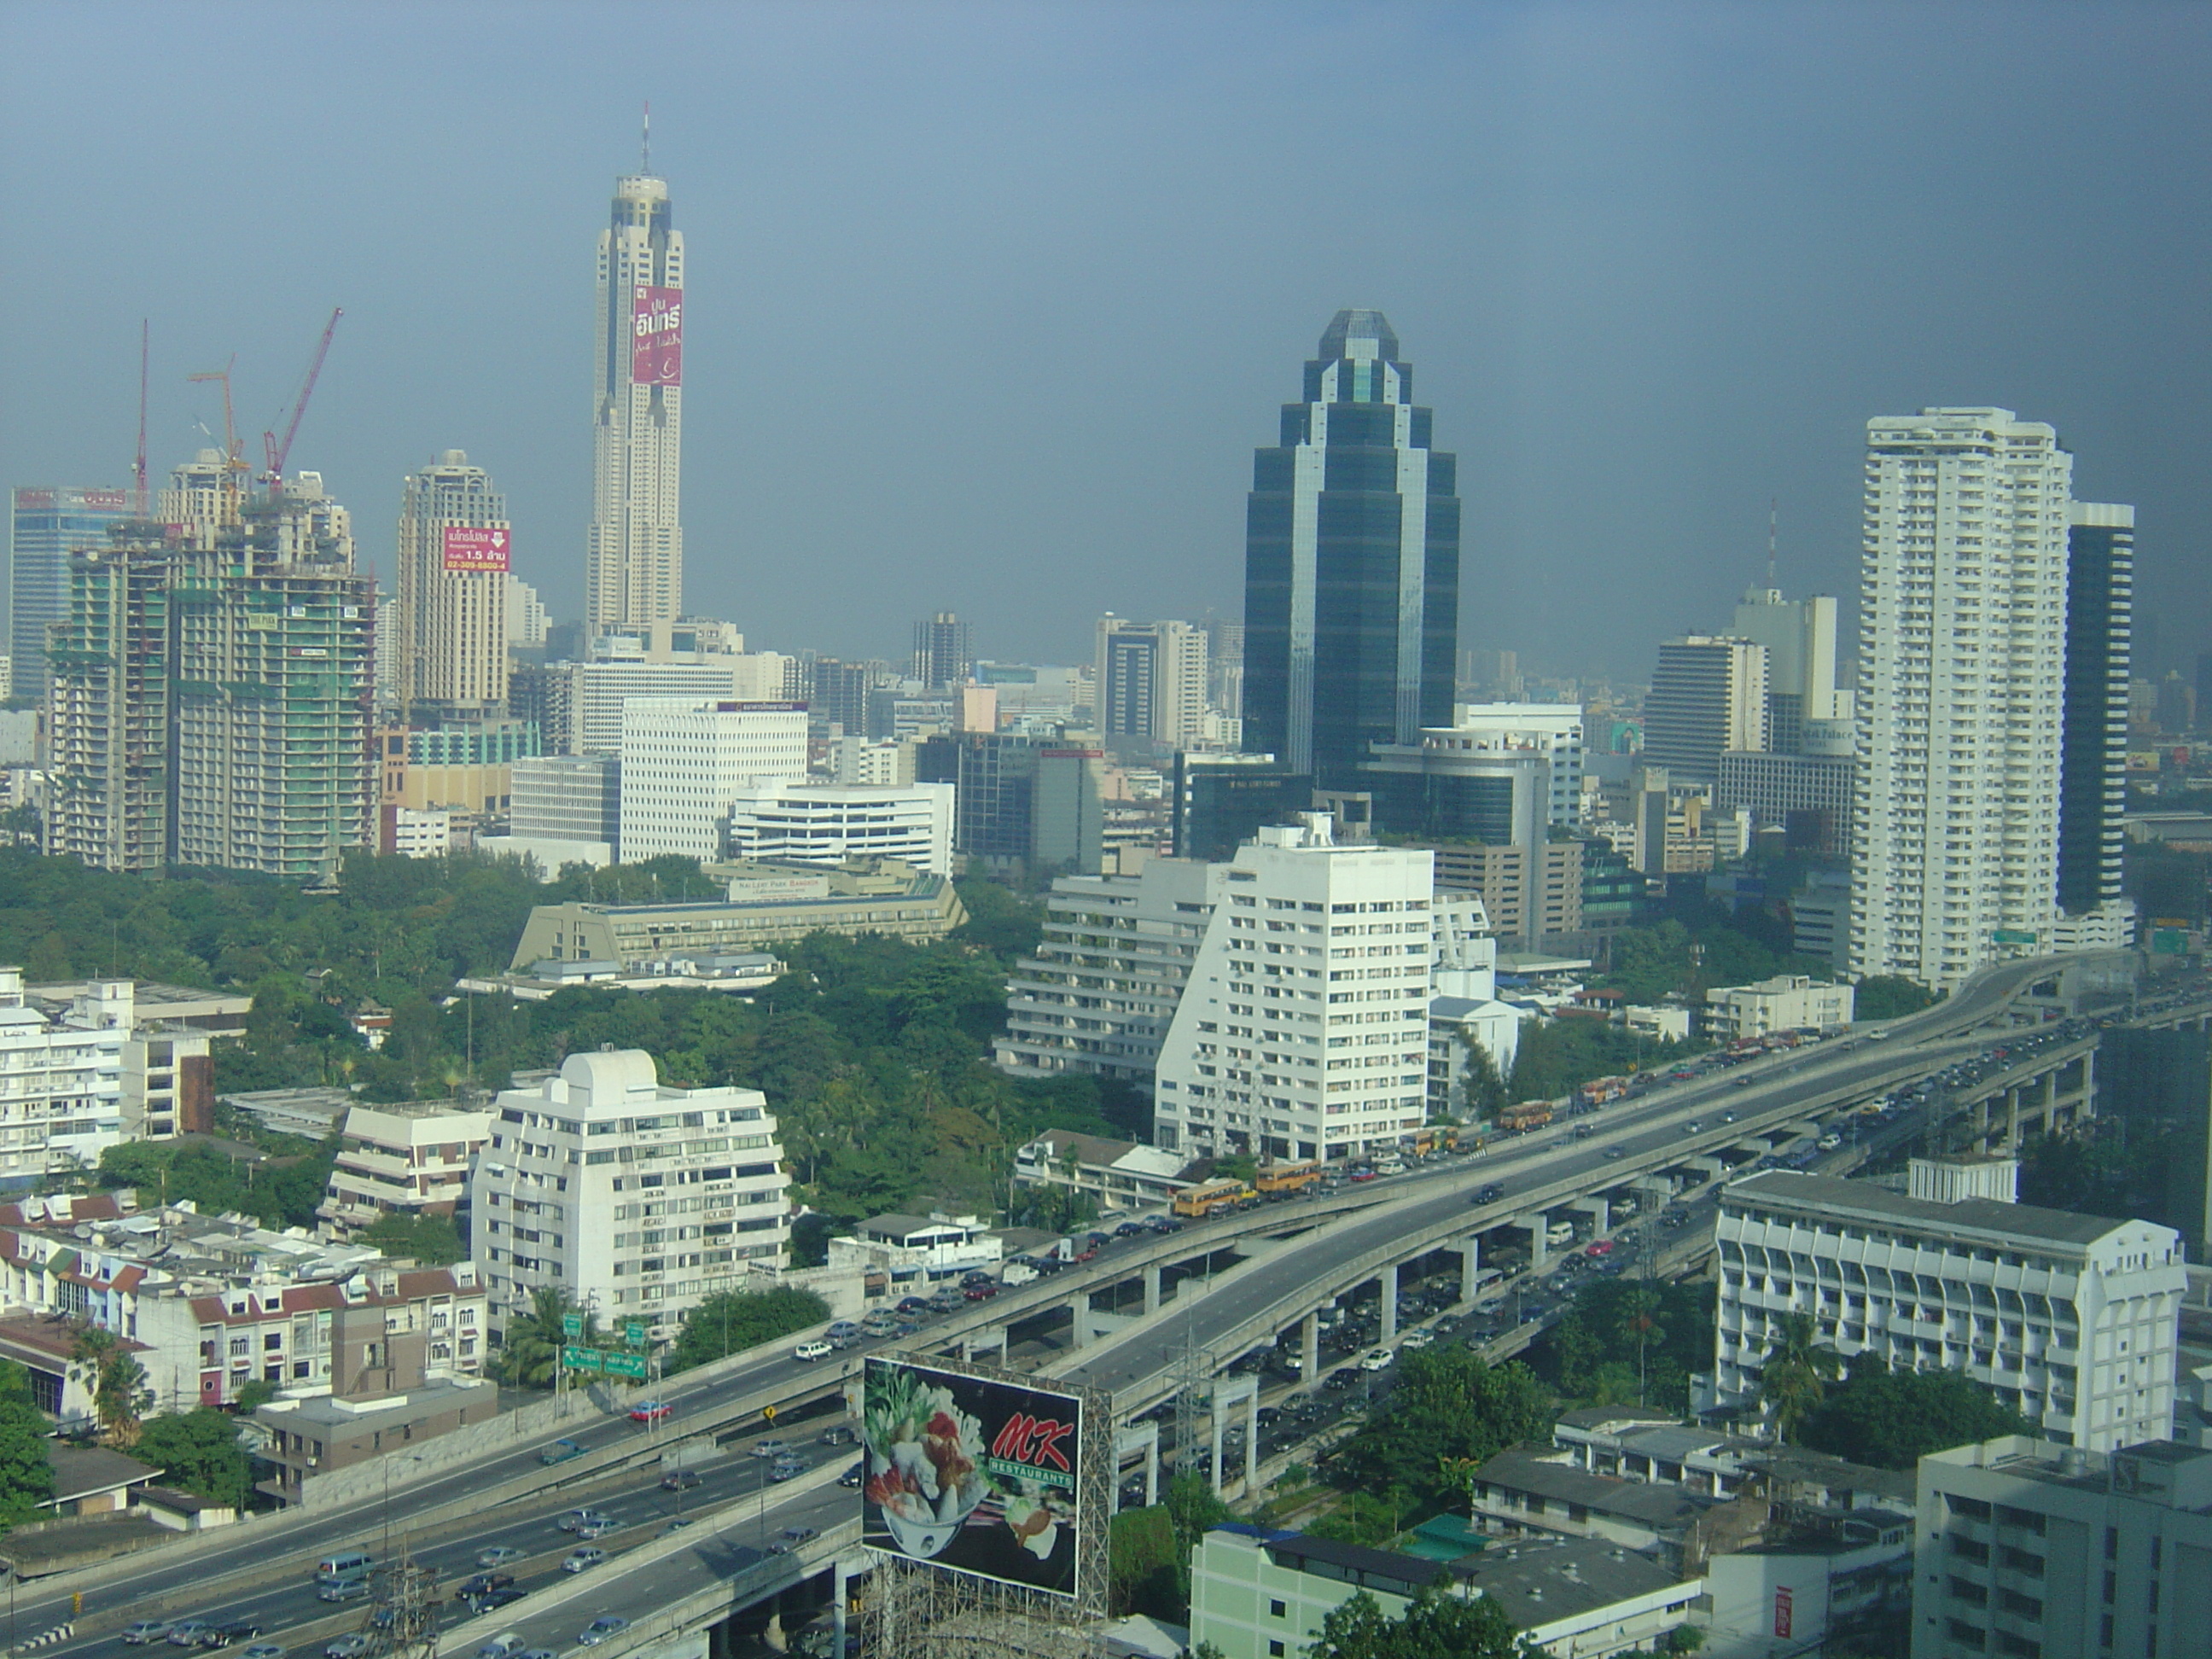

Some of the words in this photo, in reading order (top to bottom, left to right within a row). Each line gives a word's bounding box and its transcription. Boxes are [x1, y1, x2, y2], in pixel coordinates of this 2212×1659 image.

[636, 303, 680, 337] อินทรี
[466, 550, 483, 560] 1.5
[992, 1412, 1074, 1472] MK
[991, 1461, 1073, 1487] RESTAURANTS
